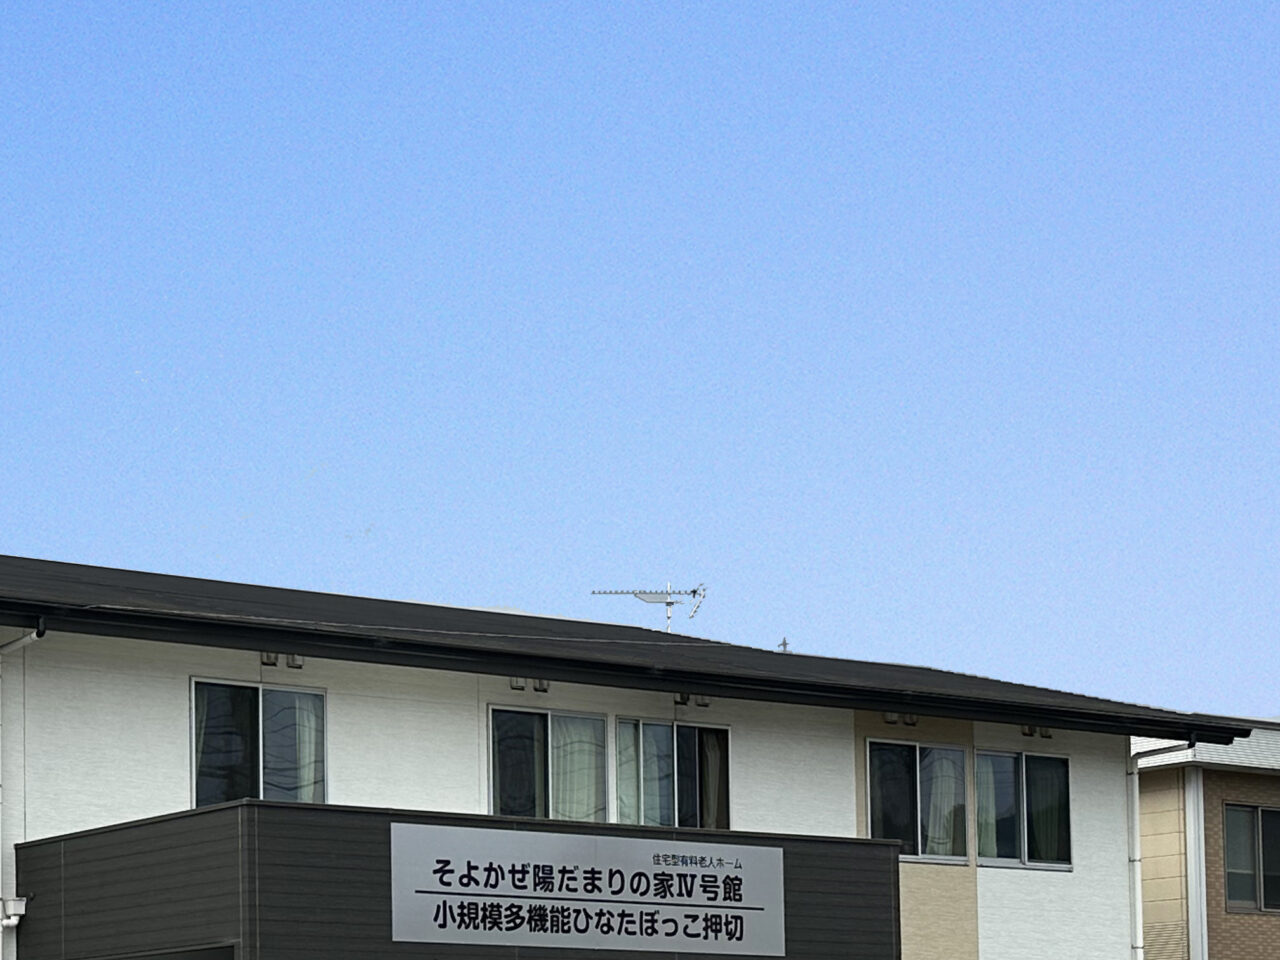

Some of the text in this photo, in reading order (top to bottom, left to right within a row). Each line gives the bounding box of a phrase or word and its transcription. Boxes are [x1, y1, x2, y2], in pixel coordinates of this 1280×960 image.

[652, 853, 743, 870] 住宅型有料老人ホーム
[432, 899, 744, 941] 小規模多機能ひなたぼっこ押切
